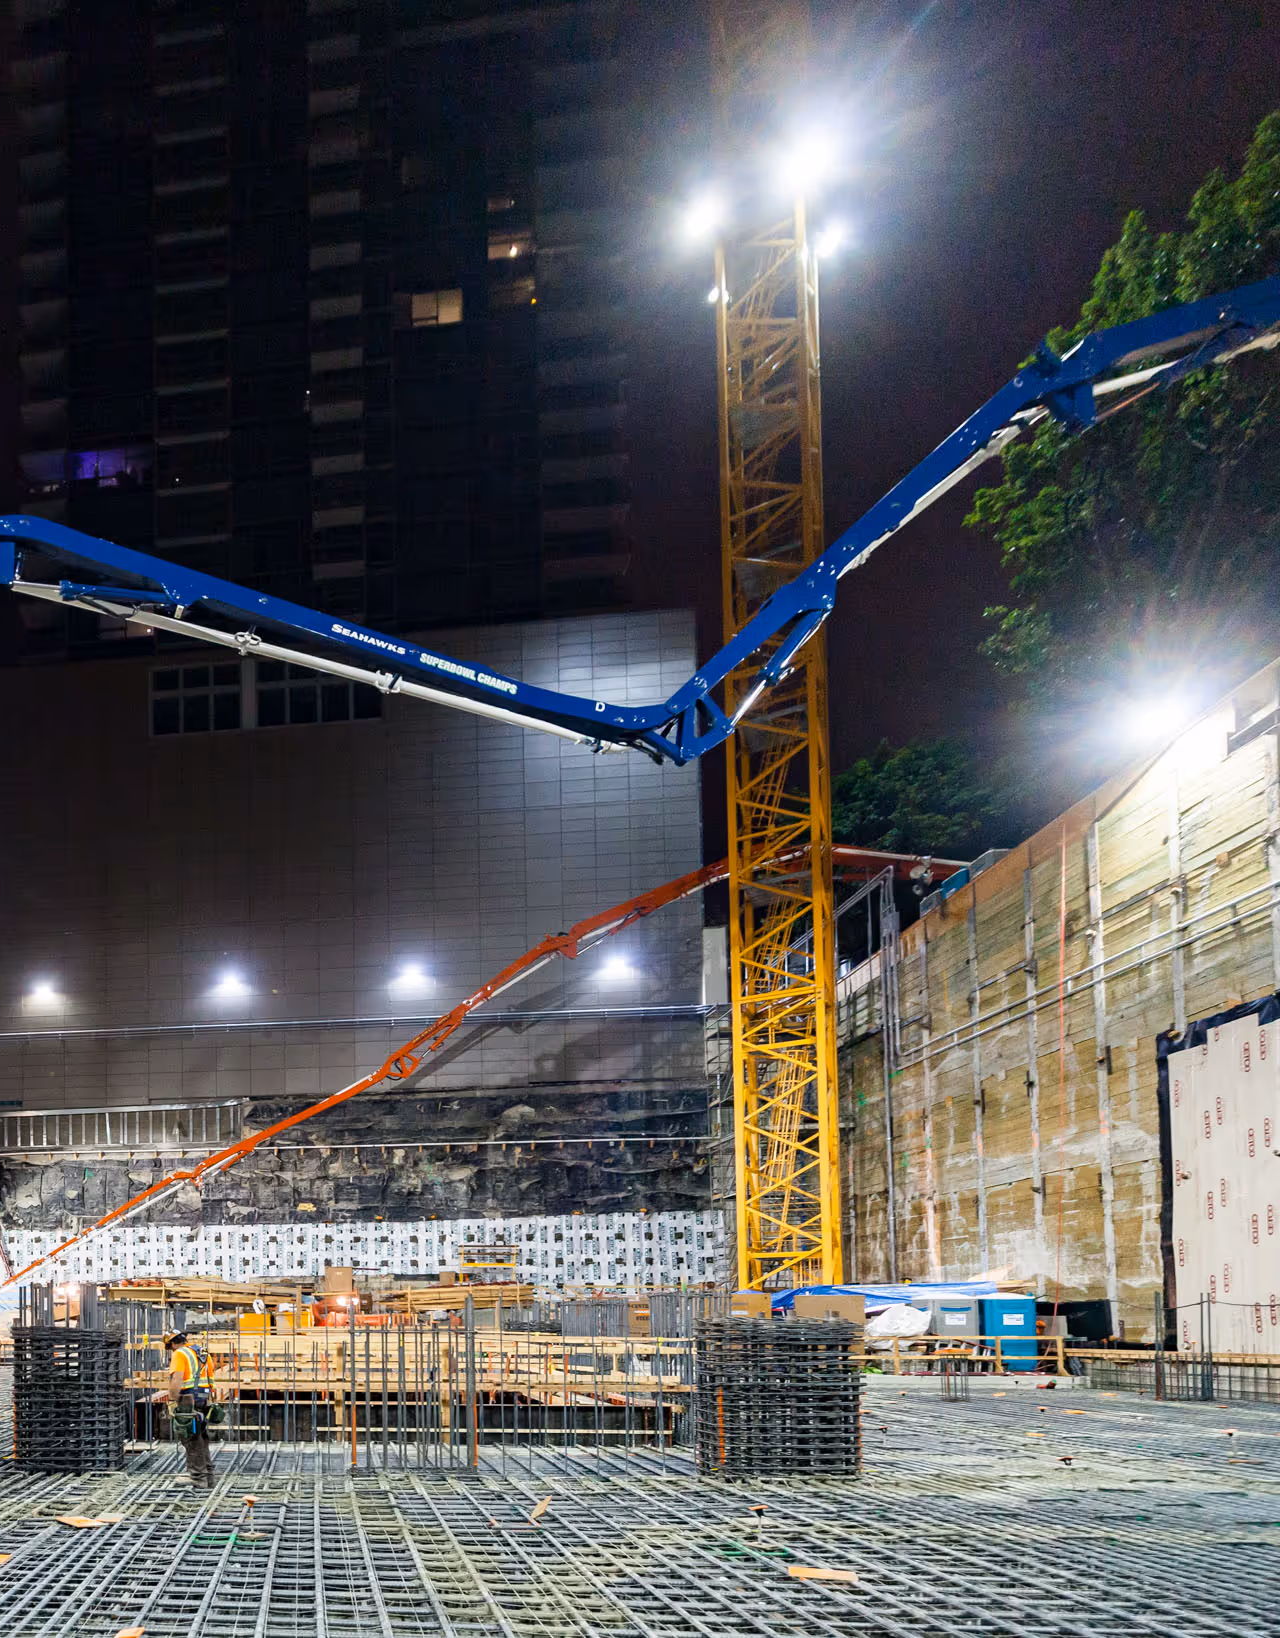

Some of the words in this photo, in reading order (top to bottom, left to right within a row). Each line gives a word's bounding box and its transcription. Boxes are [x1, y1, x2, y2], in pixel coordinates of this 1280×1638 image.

[331, 623, 406, 655] SEAHAWKS
[419, 652, 476, 681] SUPERBOWL
[477, 673, 518, 695] CHAMPS
[594, 701, 606, 712] D
